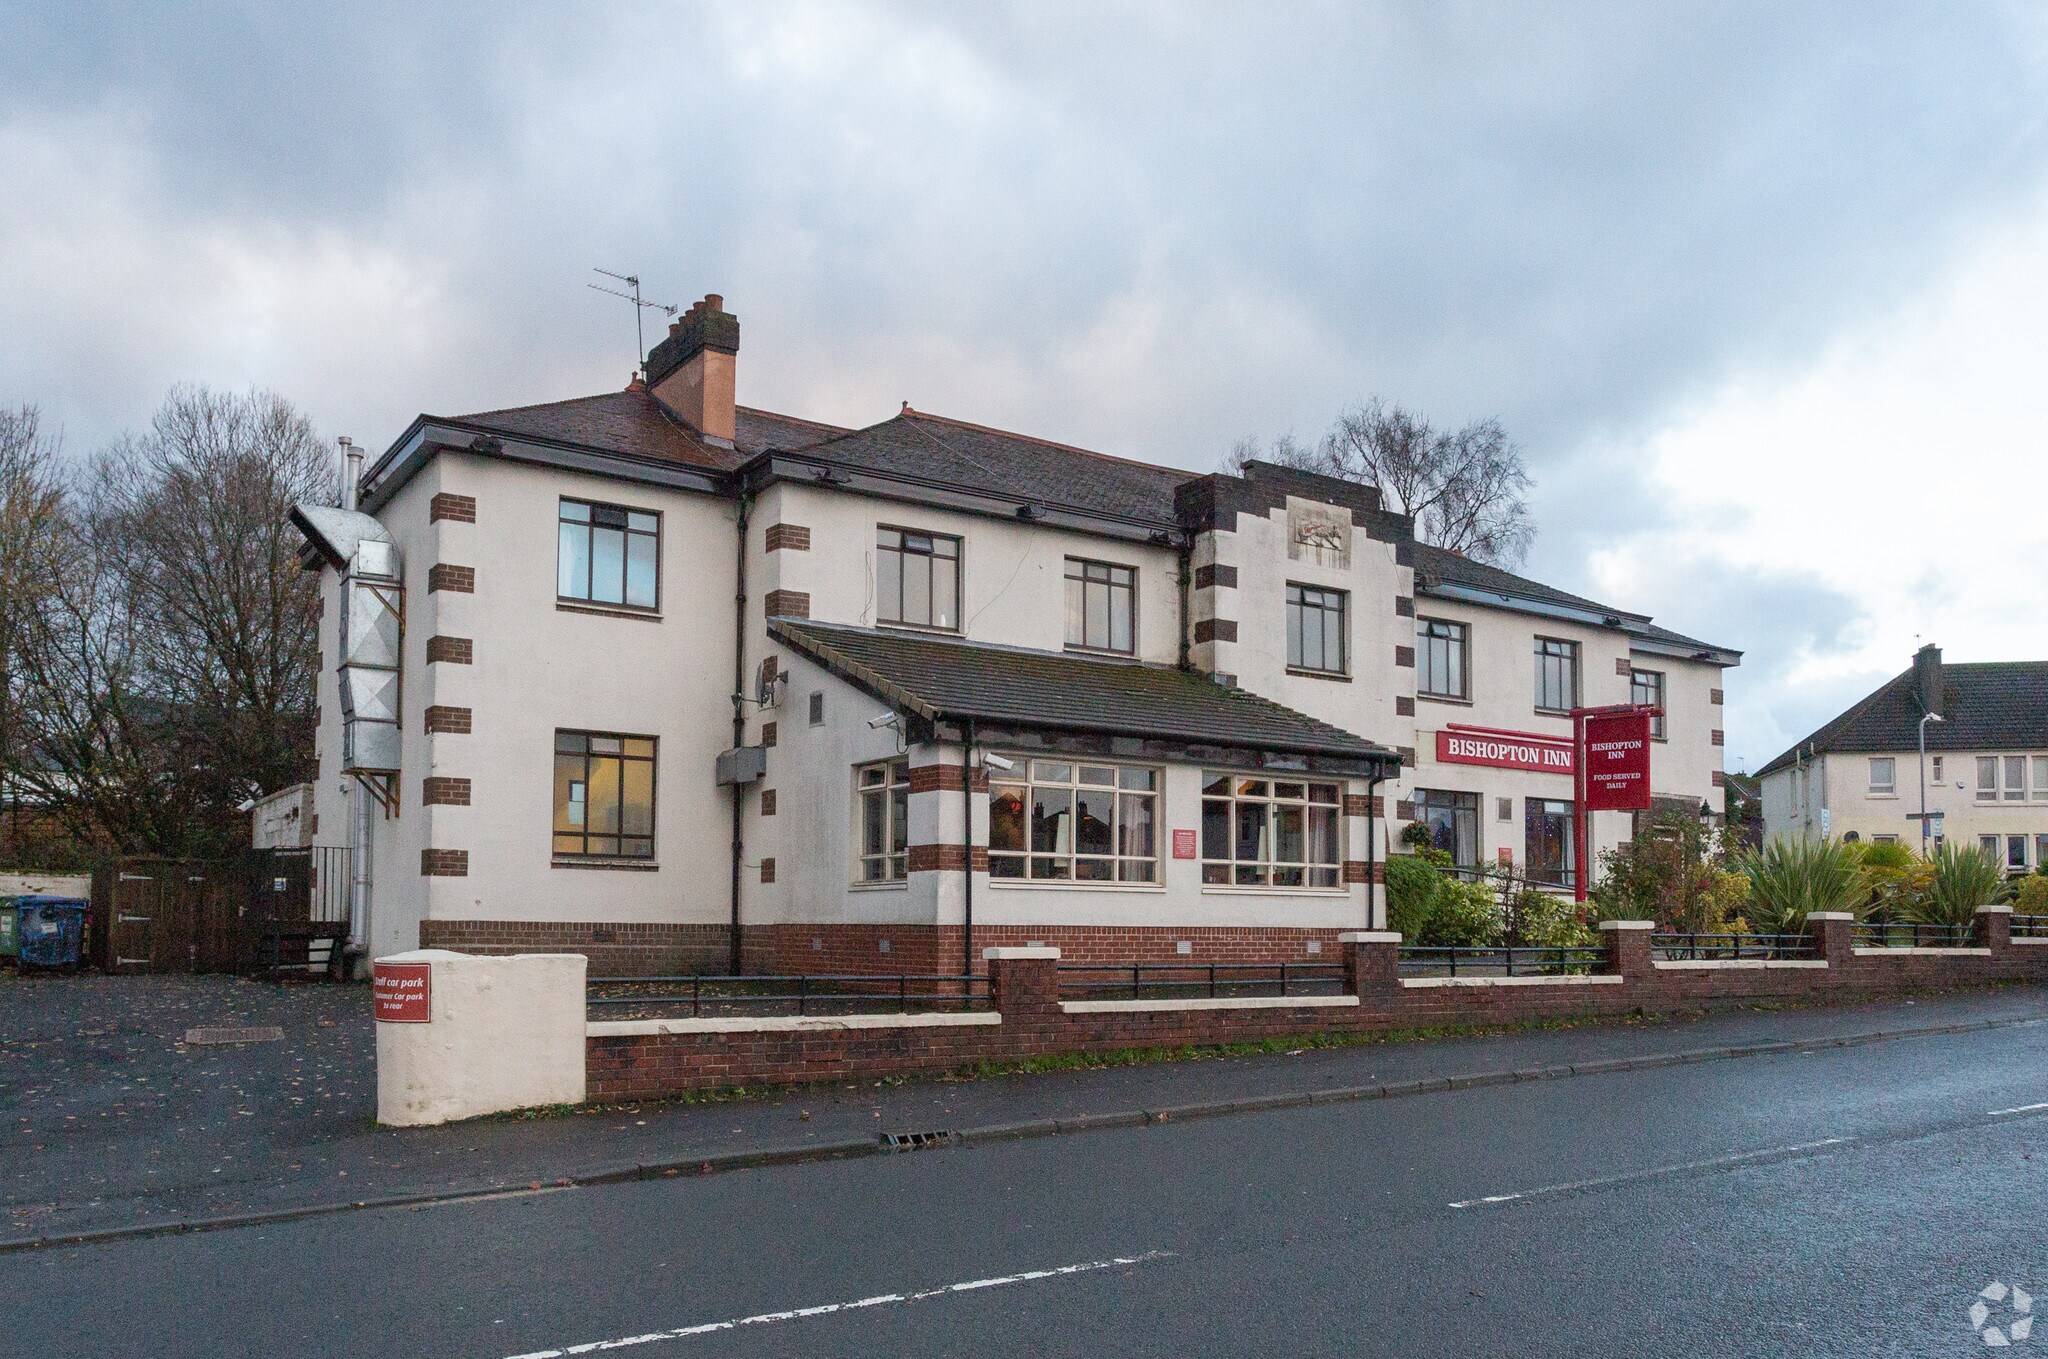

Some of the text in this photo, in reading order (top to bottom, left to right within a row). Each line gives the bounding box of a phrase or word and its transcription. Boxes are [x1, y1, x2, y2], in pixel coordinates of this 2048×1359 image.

[1591, 740, 1642, 751] BISHOPTON
[1448, 738, 1571, 767] BISHOPTON INN
[1608, 751, 1625, 759] INN
[1612, 772, 1641, 780] SERVED
[400, 978, 423, 989] park
[405, 993, 423, 1001] park
